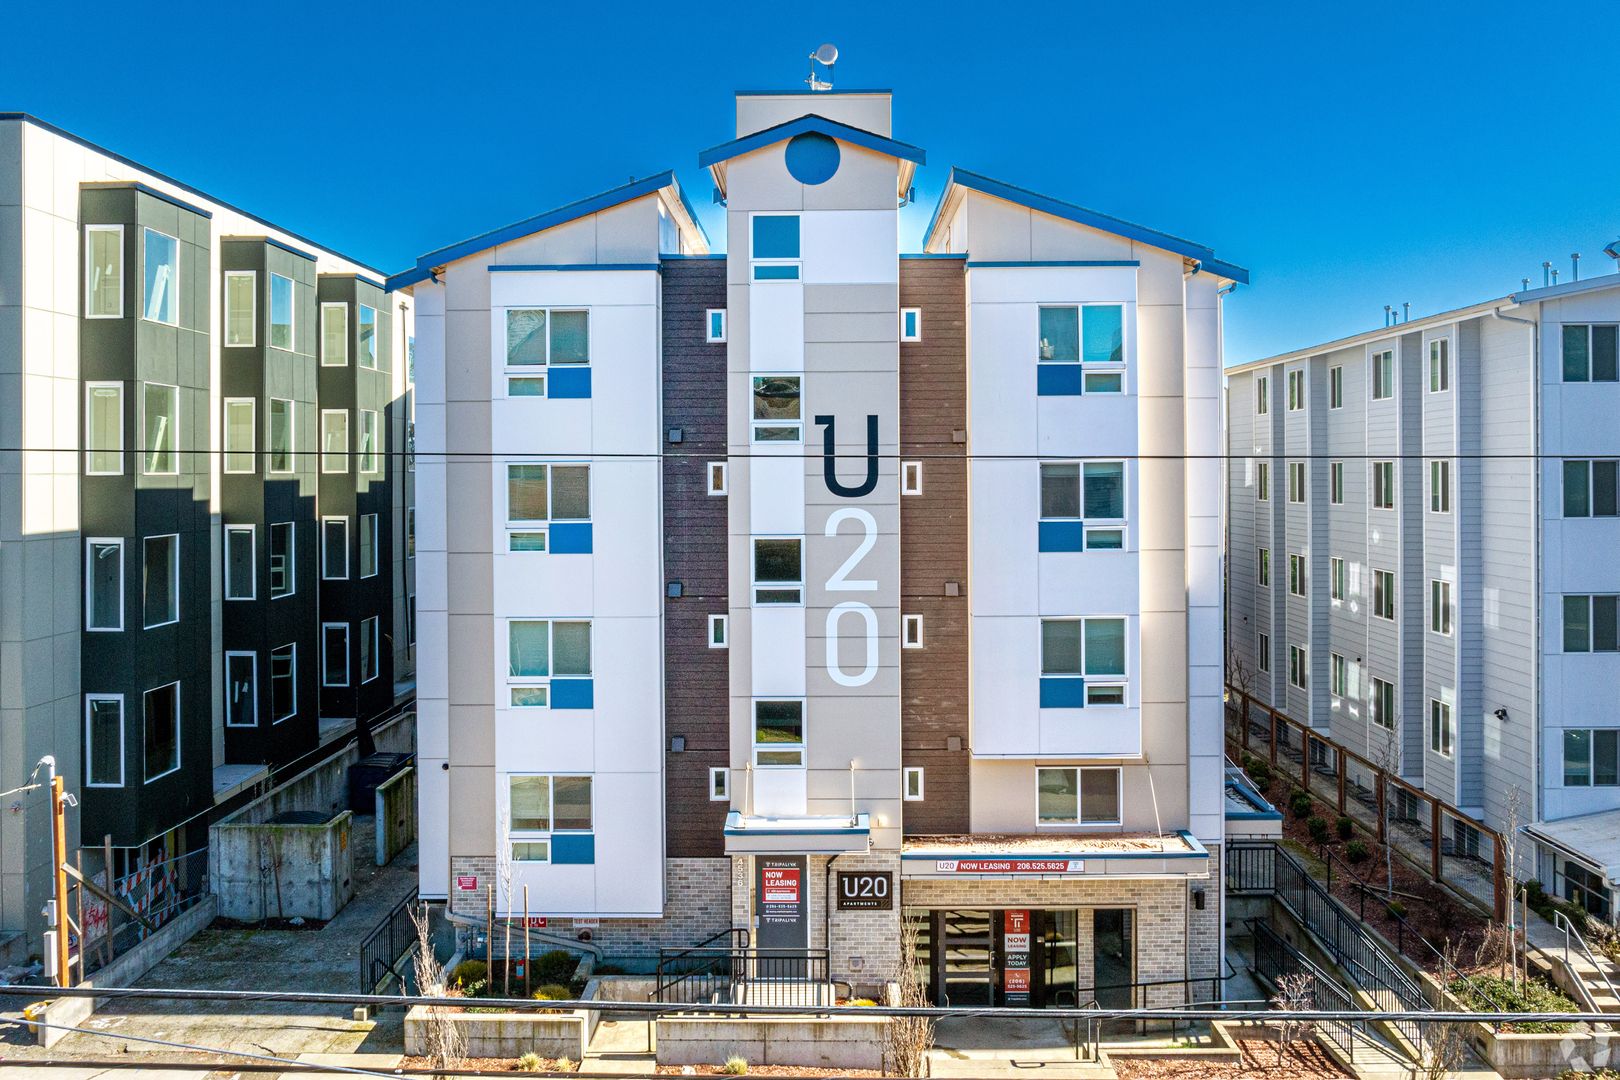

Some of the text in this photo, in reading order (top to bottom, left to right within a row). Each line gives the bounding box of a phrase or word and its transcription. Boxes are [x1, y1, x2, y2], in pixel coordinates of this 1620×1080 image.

[814, 414, 879, 687] U20
[765, 871, 783, 879] NOW
[842, 877, 887, 896] U20
